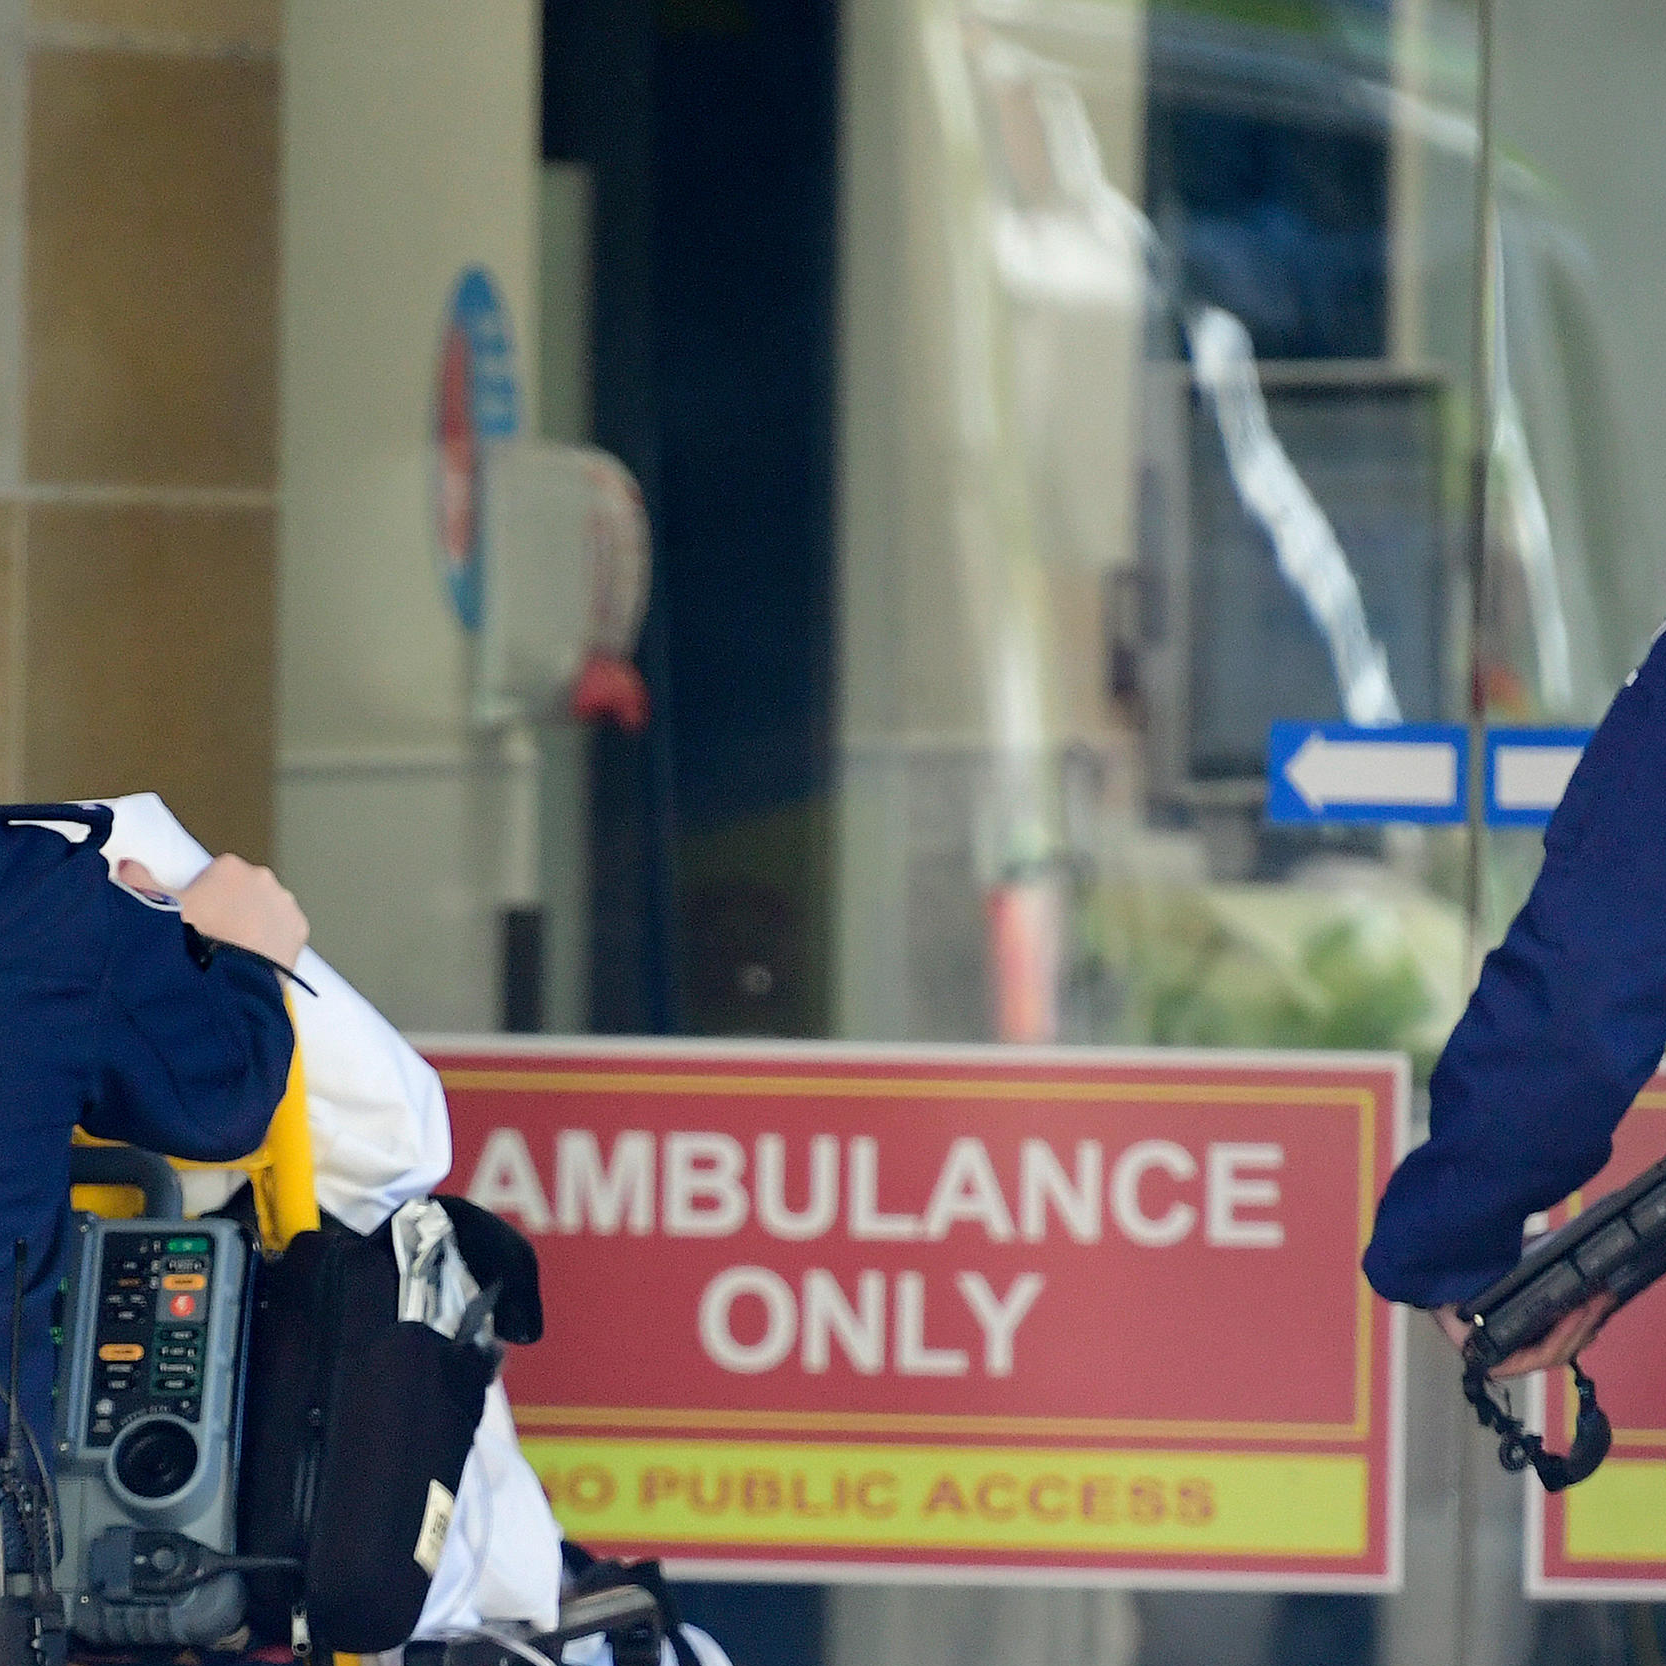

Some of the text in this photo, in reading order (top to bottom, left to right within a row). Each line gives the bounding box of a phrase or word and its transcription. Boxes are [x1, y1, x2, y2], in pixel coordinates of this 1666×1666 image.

[467, 1127, 1287, 1248] AMBULANCE
[698, 1265, 1046, 1378] ONLY
[637, 1466, 899, 1520] PUBLIC
[920, 1470, 1217, 1528] ACCESS
